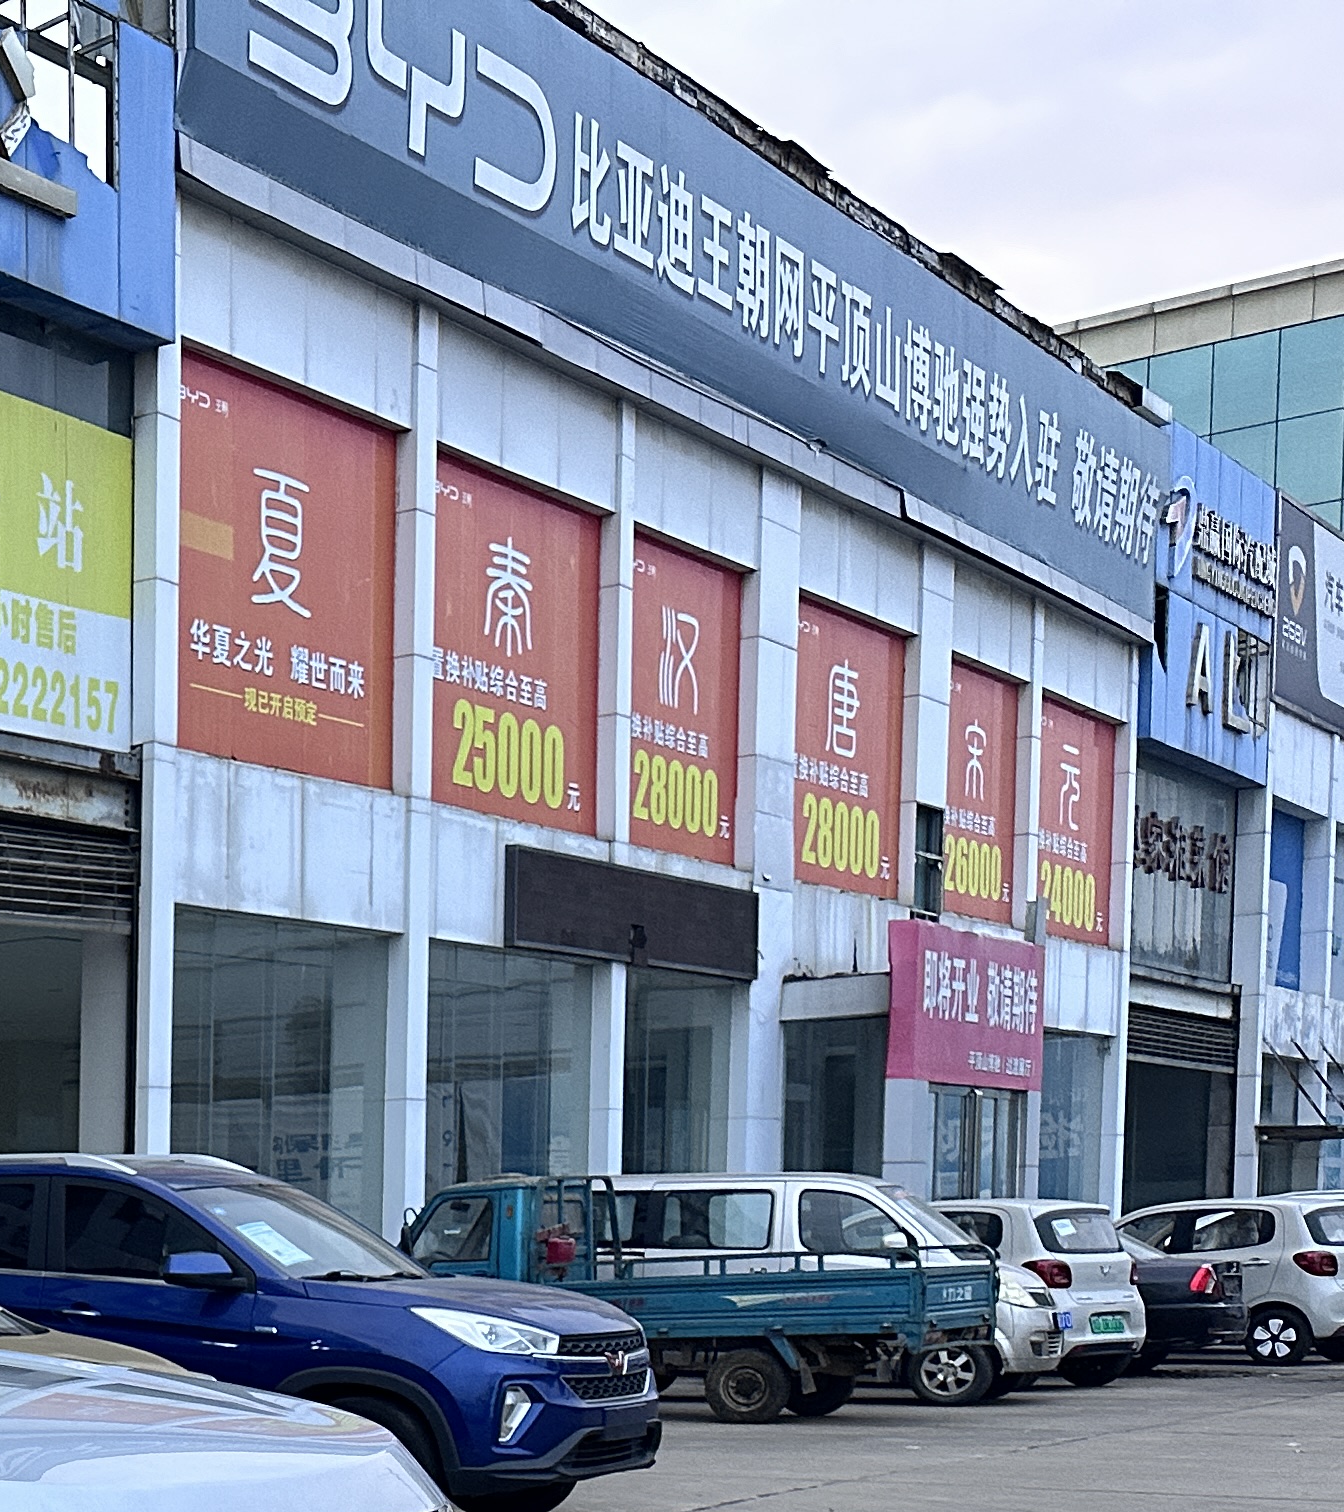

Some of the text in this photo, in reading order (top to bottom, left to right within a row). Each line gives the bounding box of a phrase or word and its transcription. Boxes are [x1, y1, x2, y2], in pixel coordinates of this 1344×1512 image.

[571, 111, 1161, 566] 比亚迪王朝网平顶山博驰强势入驻 敬请期待
[250, 467, 311, 619] 夏
[483, 536, 534, 658] 秦
[190, 617, 366, 700] 华夏之光 耀世而来
[243, 686, 319, 727] 现已开启预定
[824, 658, 861, 759] 唐
[452, 698, 581, 813] 25000 元
[633, 748, 731, 840] 28000 元
[801, 791, 890, 881] 28000 元
[944, 833, 1011, 904] 26000 元
[1040, 859, 1104, 933] 24000 元
[923, 949, 1039, 1035] 即将开业 敬请期待
